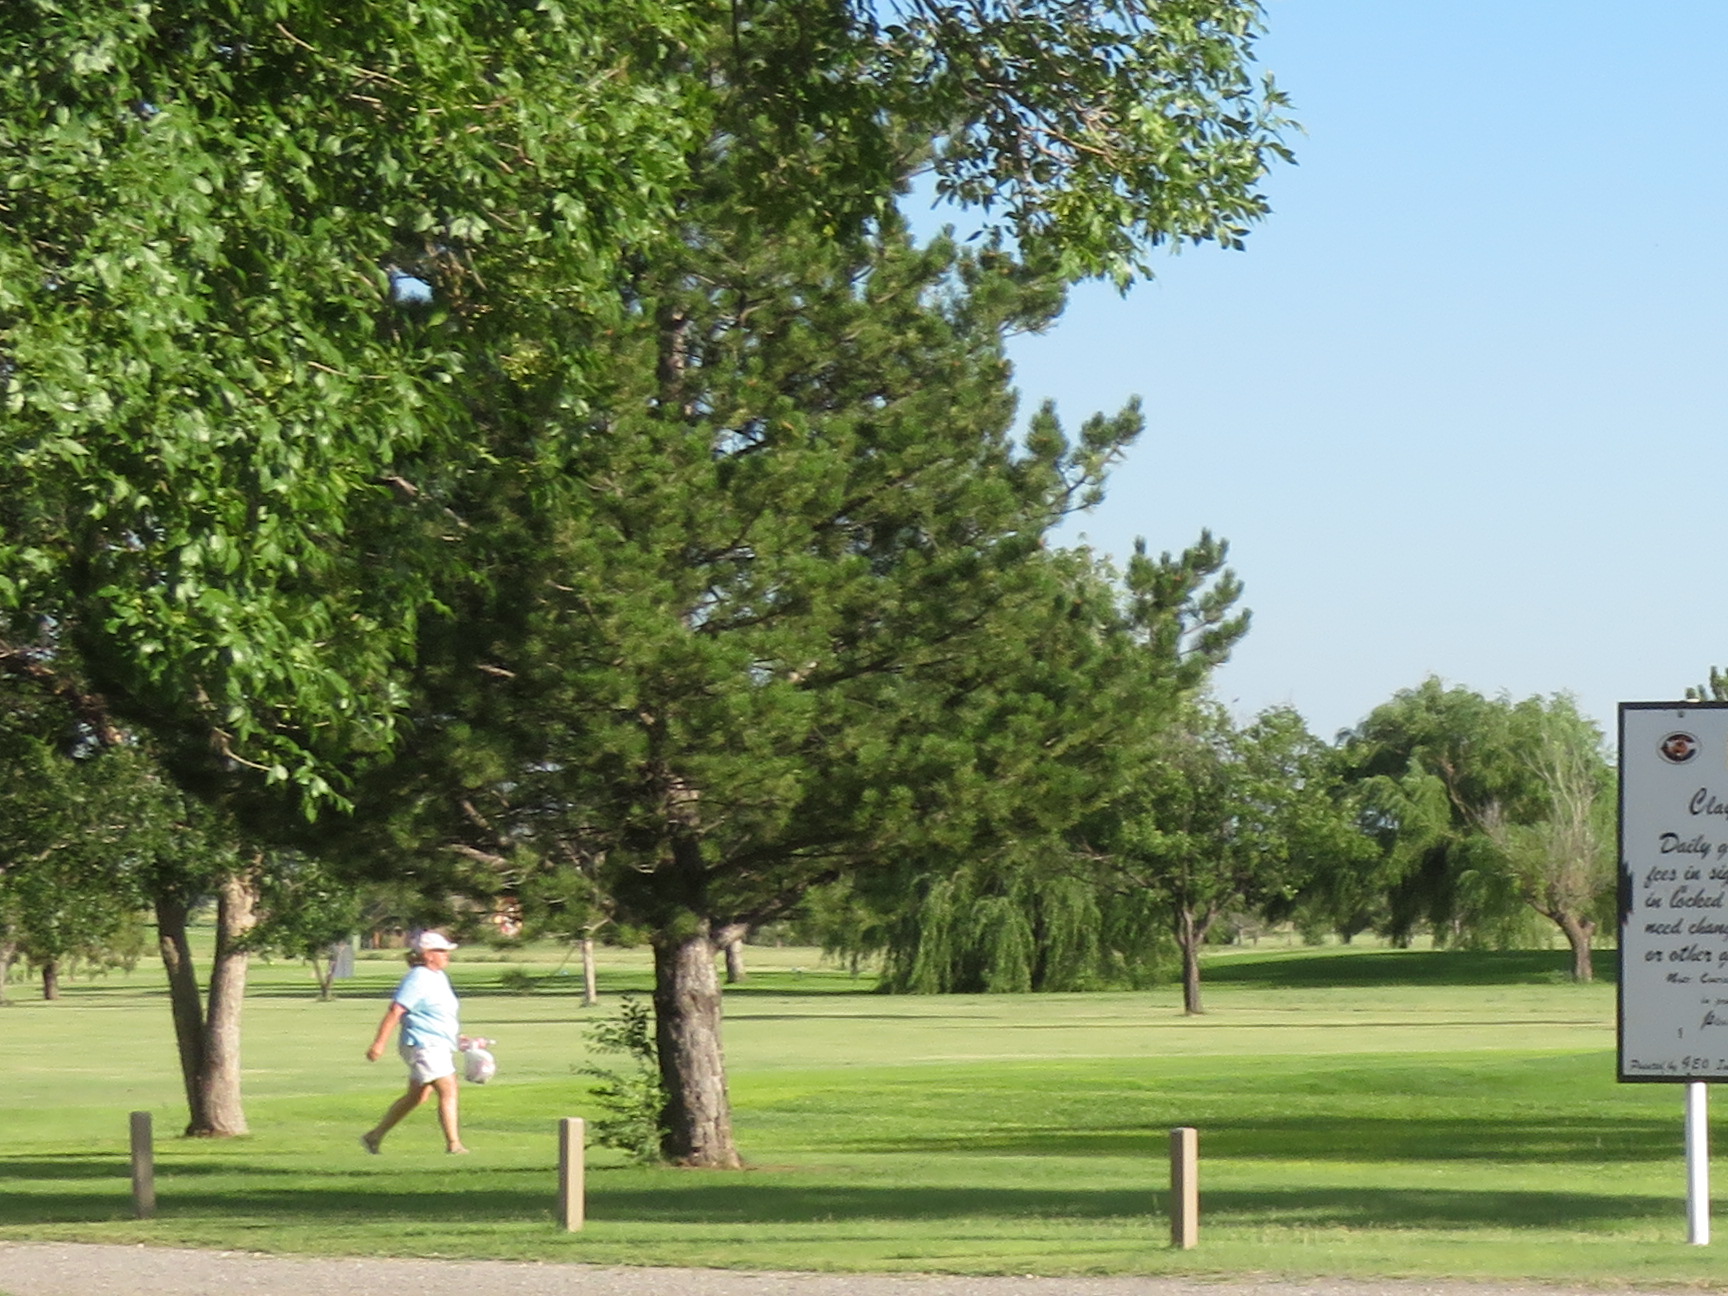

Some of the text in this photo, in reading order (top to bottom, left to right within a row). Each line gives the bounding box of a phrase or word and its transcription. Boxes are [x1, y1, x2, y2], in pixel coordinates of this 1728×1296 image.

[1659, 832, 1712, 860] Daily
[1643, 866, 1677, 888] fees
[1684, 865, 1700, 880] in
[1645, 892, 1663, 908] in
[1669, 886, 1725, 909] locked
[1645, 917, 1683, 935] need
[1645, 949, 1663, 962] or
[1669, 943, 1712, 962] other
